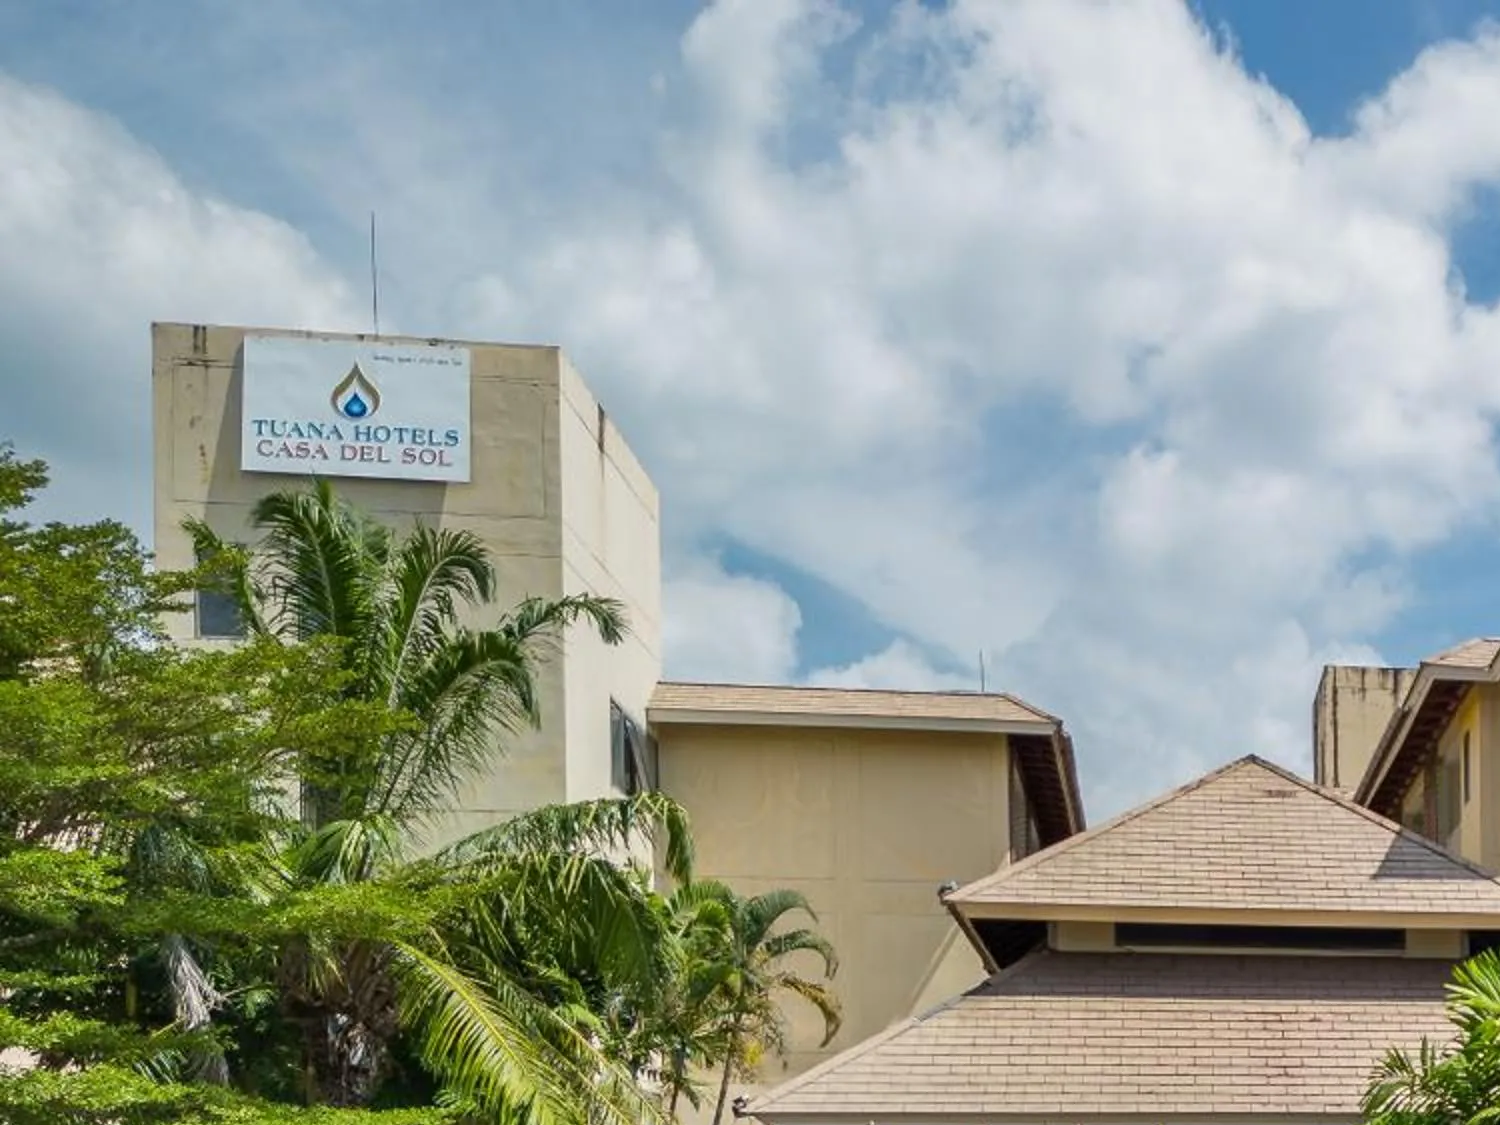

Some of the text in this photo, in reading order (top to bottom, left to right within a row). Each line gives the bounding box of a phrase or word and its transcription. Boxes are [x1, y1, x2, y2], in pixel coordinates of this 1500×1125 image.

[252, 419, 460, 447] TUANA HOTELS
[256, 440, 453, 467] CASA DEL SOL
